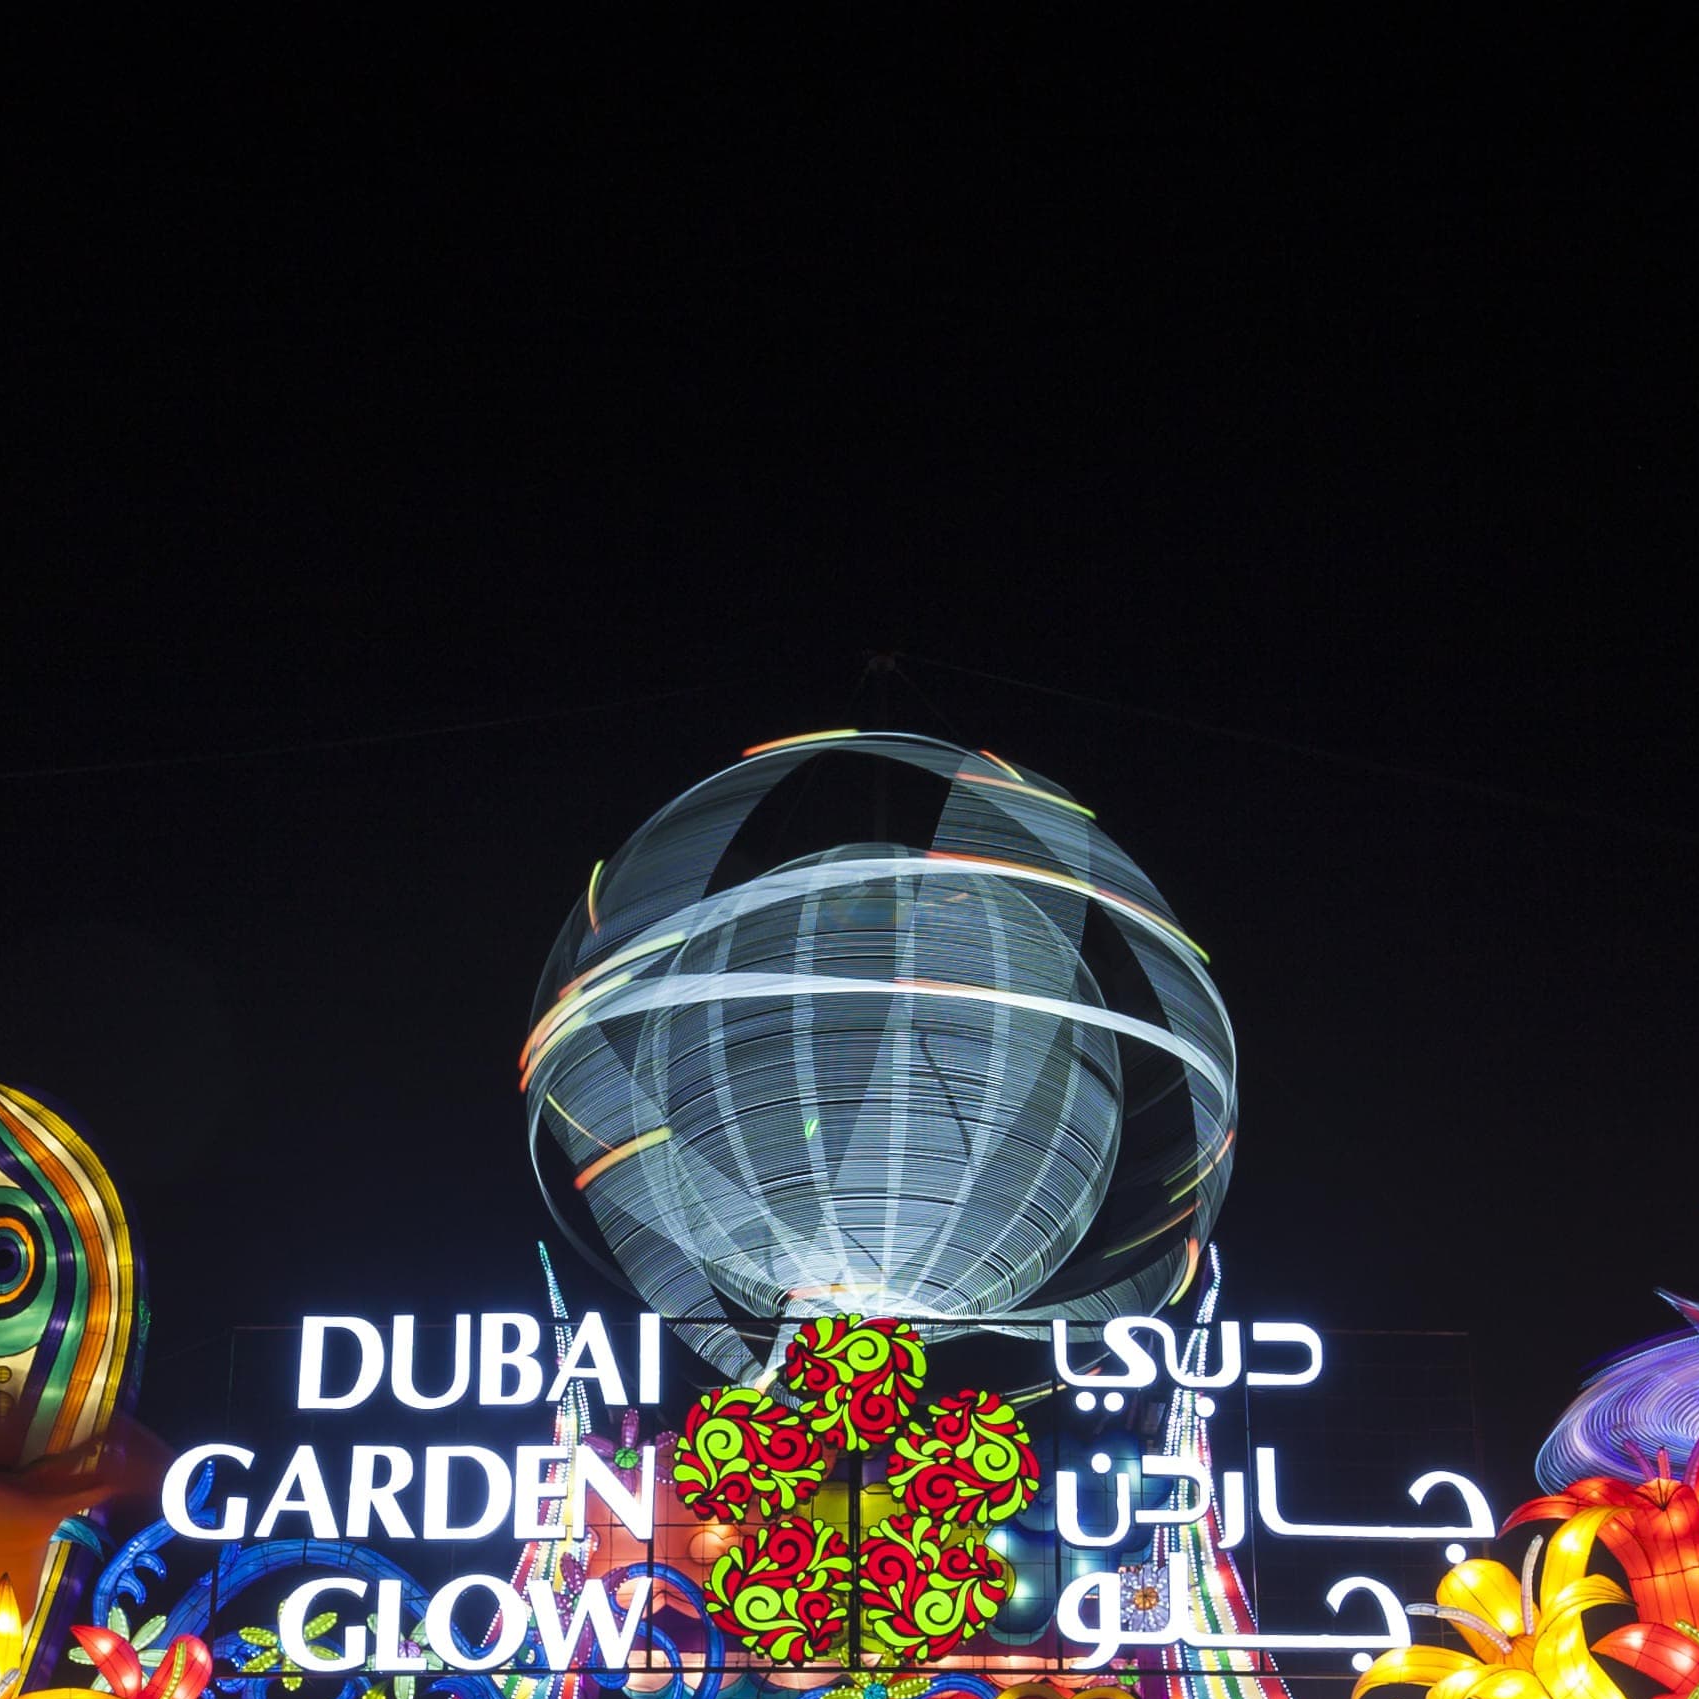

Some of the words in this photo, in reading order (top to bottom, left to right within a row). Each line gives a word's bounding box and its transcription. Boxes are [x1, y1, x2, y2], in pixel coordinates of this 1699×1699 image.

[297, 1312, 661, 1411] DUBAI
[1051, 1315, 1323, 1418] دبي
[161, 1442, 656, 1541] GARDEN
[1055, 1446, 1496, 1565] جاردن
[278, 1574, 653, 1672] GLOW
[1055, 1550, 1412, 1673] جلو
